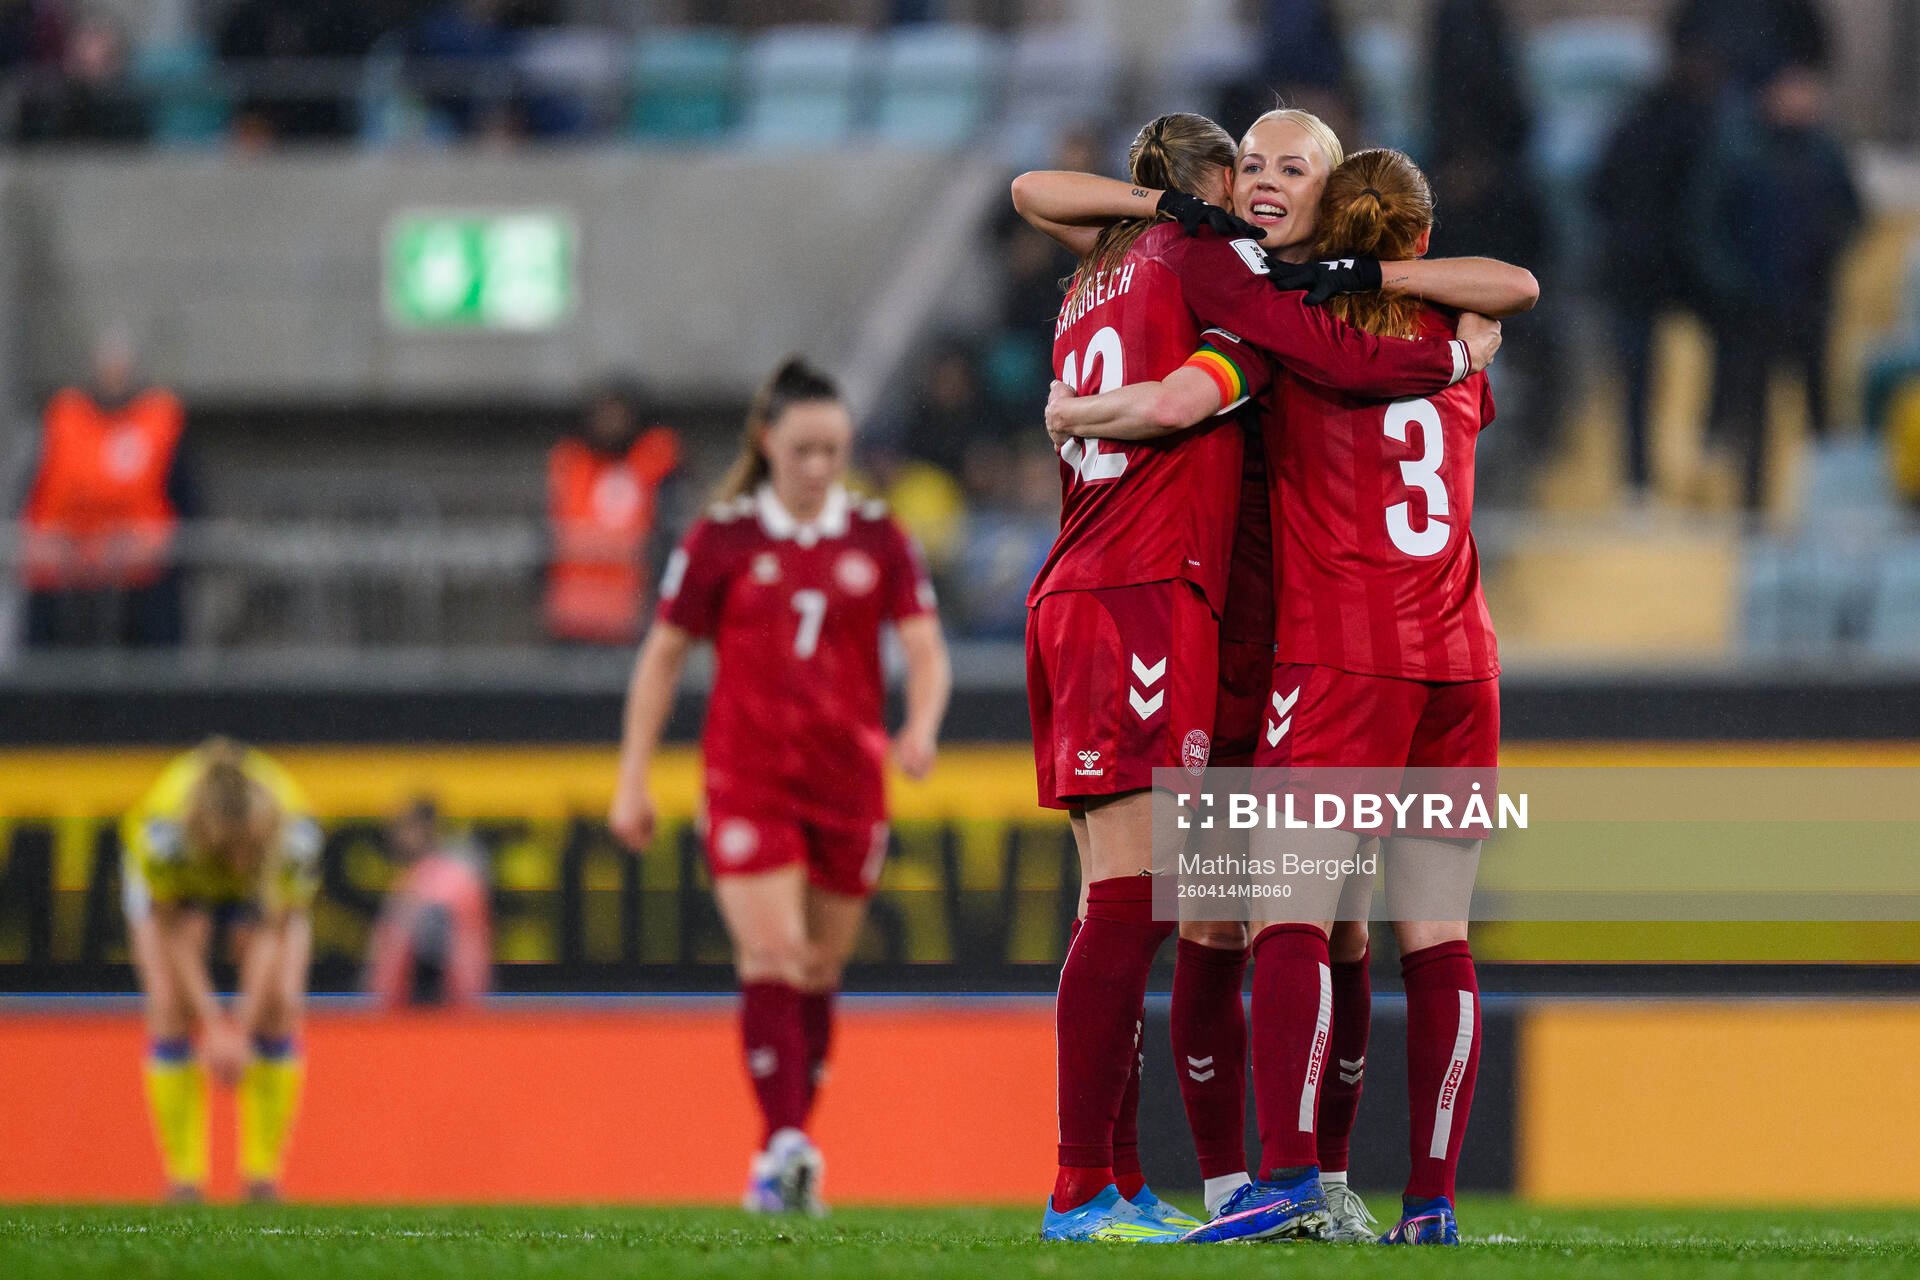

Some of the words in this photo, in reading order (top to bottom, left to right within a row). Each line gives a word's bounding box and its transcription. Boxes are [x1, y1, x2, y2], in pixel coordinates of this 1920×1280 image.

[1384, 397, 1450, 557] 3
[790, 588, 827, 660] 7
[1074, 767, 1104, 776] hummel
